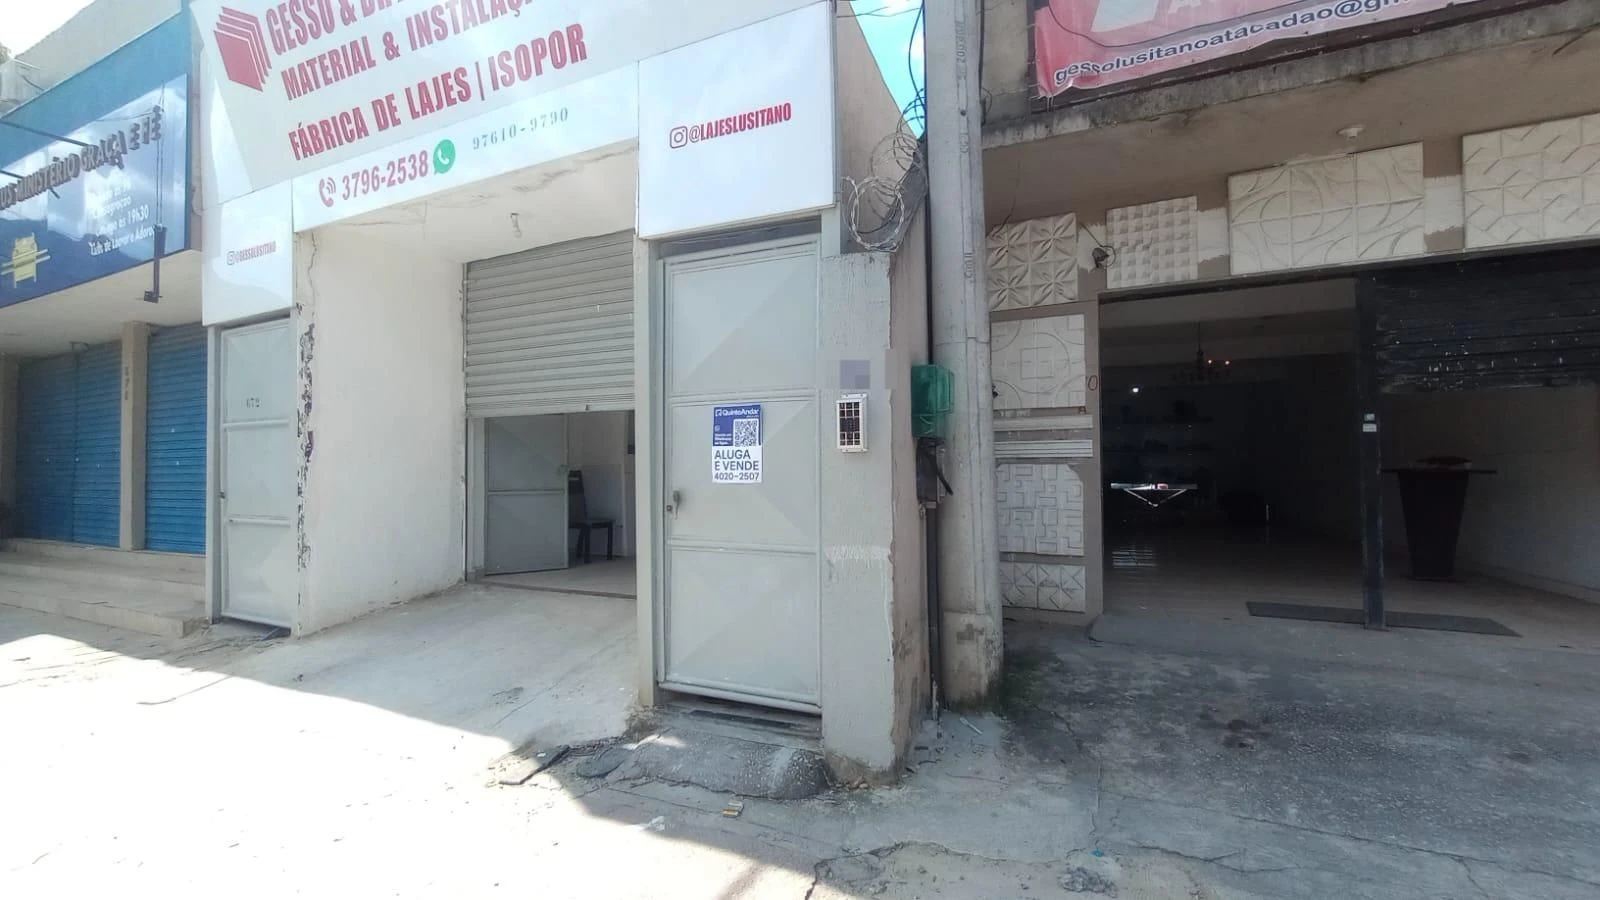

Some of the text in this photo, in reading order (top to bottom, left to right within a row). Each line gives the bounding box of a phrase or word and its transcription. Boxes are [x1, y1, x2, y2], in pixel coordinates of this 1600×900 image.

[265, 0, 335, 56] GESSO
[281, 0, 533, 101] MATERIAL & INSTALA
[1055, 0, 1408, 86] gessolusitanoatacadao@g
[288, 106, 370, 161] FÁBRICA
[371, 93, 402, 132] DE
[405, 67, 472, 120] LAJES
[487, 23, 588, 91] ISOPOR
[689, 102, 792, 144] @LAJESLUSITANO
[342, 106, 568, 201] 3796-2538 97610-9790
[714, 449, 751, 460] ALUGA
[714, 460, 760, 471] E VENDE
[714, 471, 760, 481] 4020-2507
